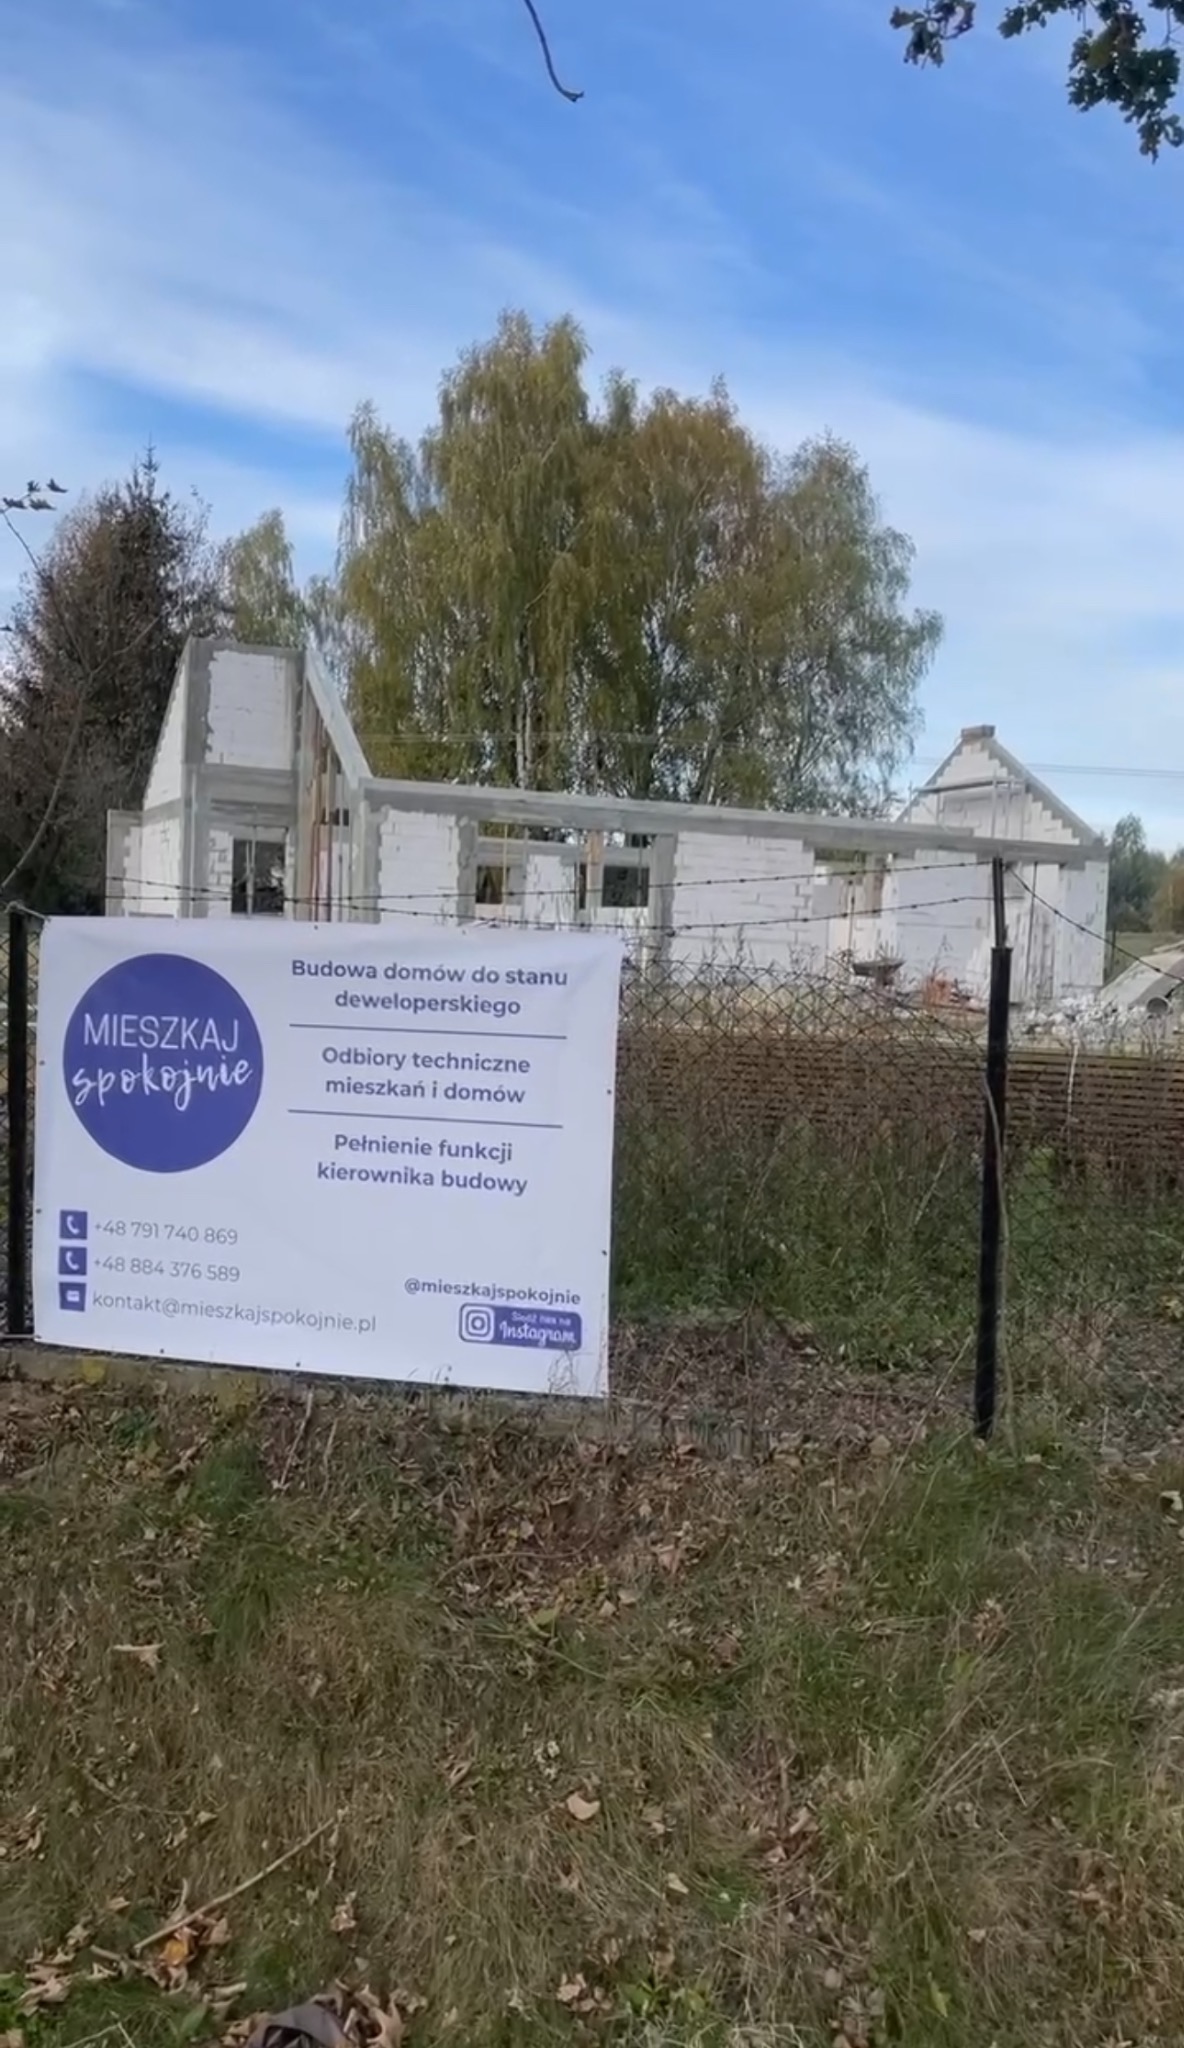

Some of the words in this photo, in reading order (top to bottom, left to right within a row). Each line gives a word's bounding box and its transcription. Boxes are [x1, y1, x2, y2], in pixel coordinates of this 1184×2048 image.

[292, 960, 377, 979] Budowa
[384, 963, 465, 982] domów
[472, 966, 499, 984] do
[505, 969, 568, 986] stanu
[335, 991, 521, 1018] deweloperskiego
[84, 1013, 239, 1052] MIESZKAJ
[322, 1047, 406, 1070] Odbiory
[412, 1052, 531, 1073] techniczne
[72, 1053, 253, 1111] spokojnie
[325, 1077, 425, 1098] mieszkań
[431, 1081, 438, 1100] i
[444, 1083, 525, 1103] domów
[334, 1134, 432, 1156] Pełnienie
[439, 1140, 512, 1164] funkcji
[317, 1163, 434, 1186] kierownika
[441, 1170, 527, 1196] budowy
[94, 1220, 126, 1236] +48
[131, 1221, 158, 1239] 791
[165, 1224, 199, 1242] 740
[204, 1228, 238, 1245] 869
[93, 1256, 125, 1272] +48
[130, 1258, 164, 1276] 884
[170, 1261, 202, 1279] 376
[207, 1265, 240, 1282] 589
[405, 1278, 581, 1305] @mieszkajspokojnie
[93, 1291, 376, 1334] kontakt@mieszkajspokojnie.pl
[500, 1320, 576, 1346] Instagram
